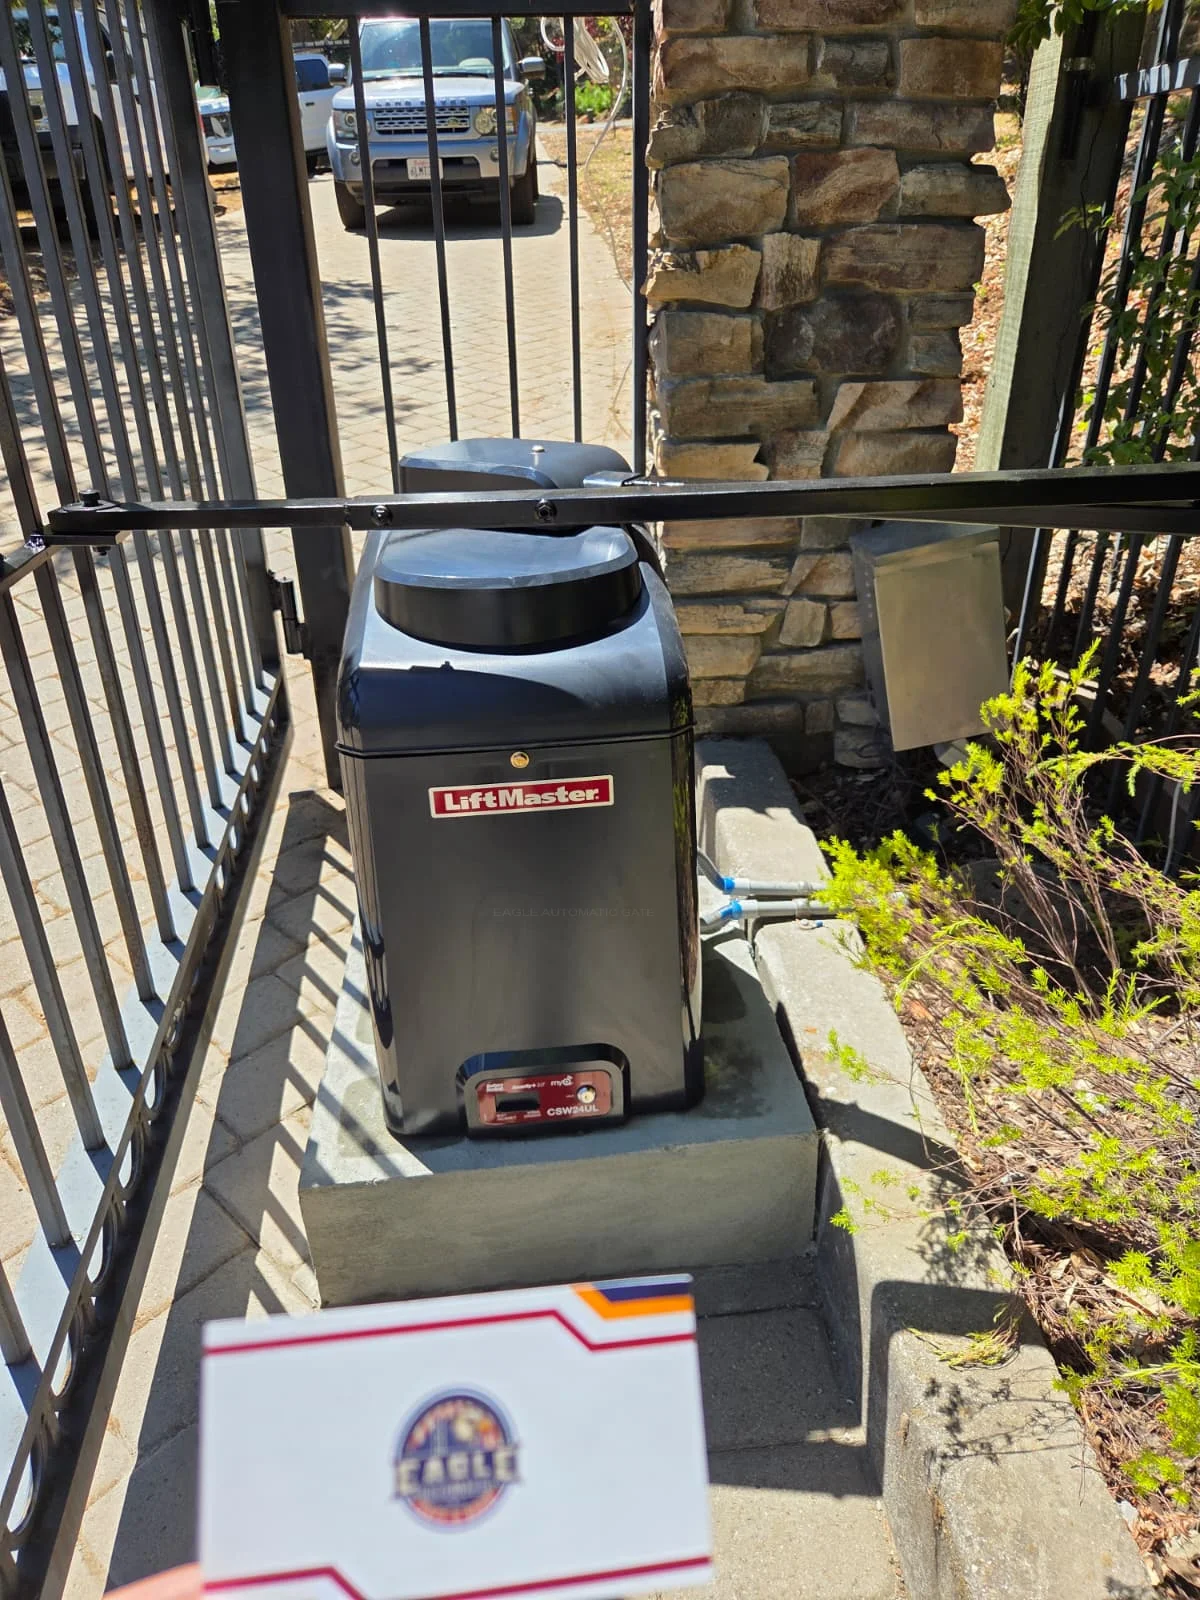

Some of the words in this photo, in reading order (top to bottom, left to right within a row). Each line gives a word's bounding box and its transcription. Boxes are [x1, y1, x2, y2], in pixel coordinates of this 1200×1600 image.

[444, 786, 599, 811] LiftMaster
[547, 1104, 599, 1117] CSW24UL
[392, 1445, 521, 1500] EAGLE
